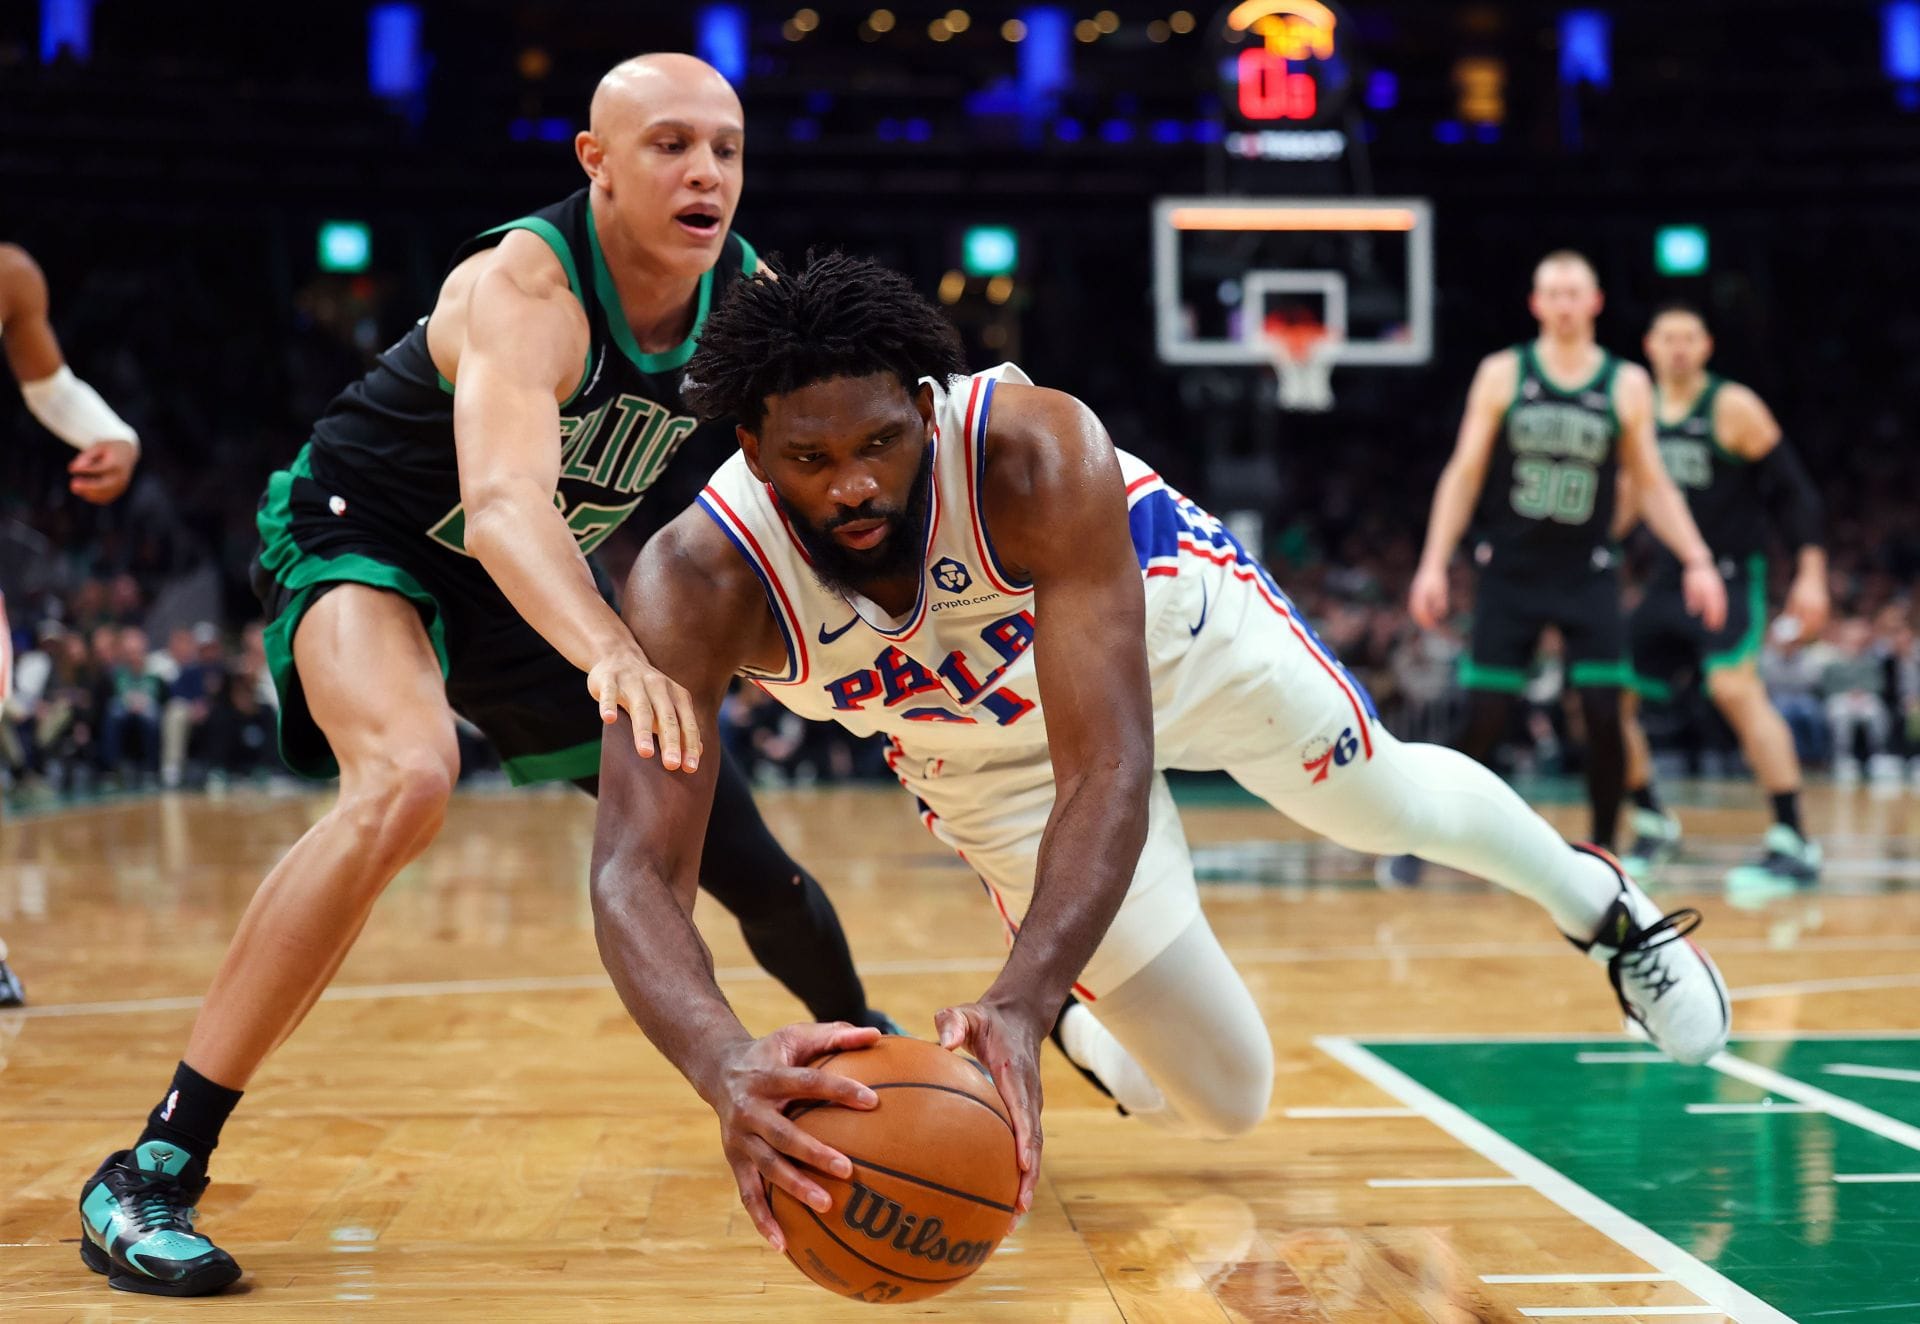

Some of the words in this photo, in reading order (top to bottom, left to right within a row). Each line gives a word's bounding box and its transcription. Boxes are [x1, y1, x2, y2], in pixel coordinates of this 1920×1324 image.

[1509, 456, 1598, 525] 30
[931, 592, 1000, 612] crypto.com
[1302, 727, 1359, 785] 76
[844, 1181, 993, 1266] Wilson
